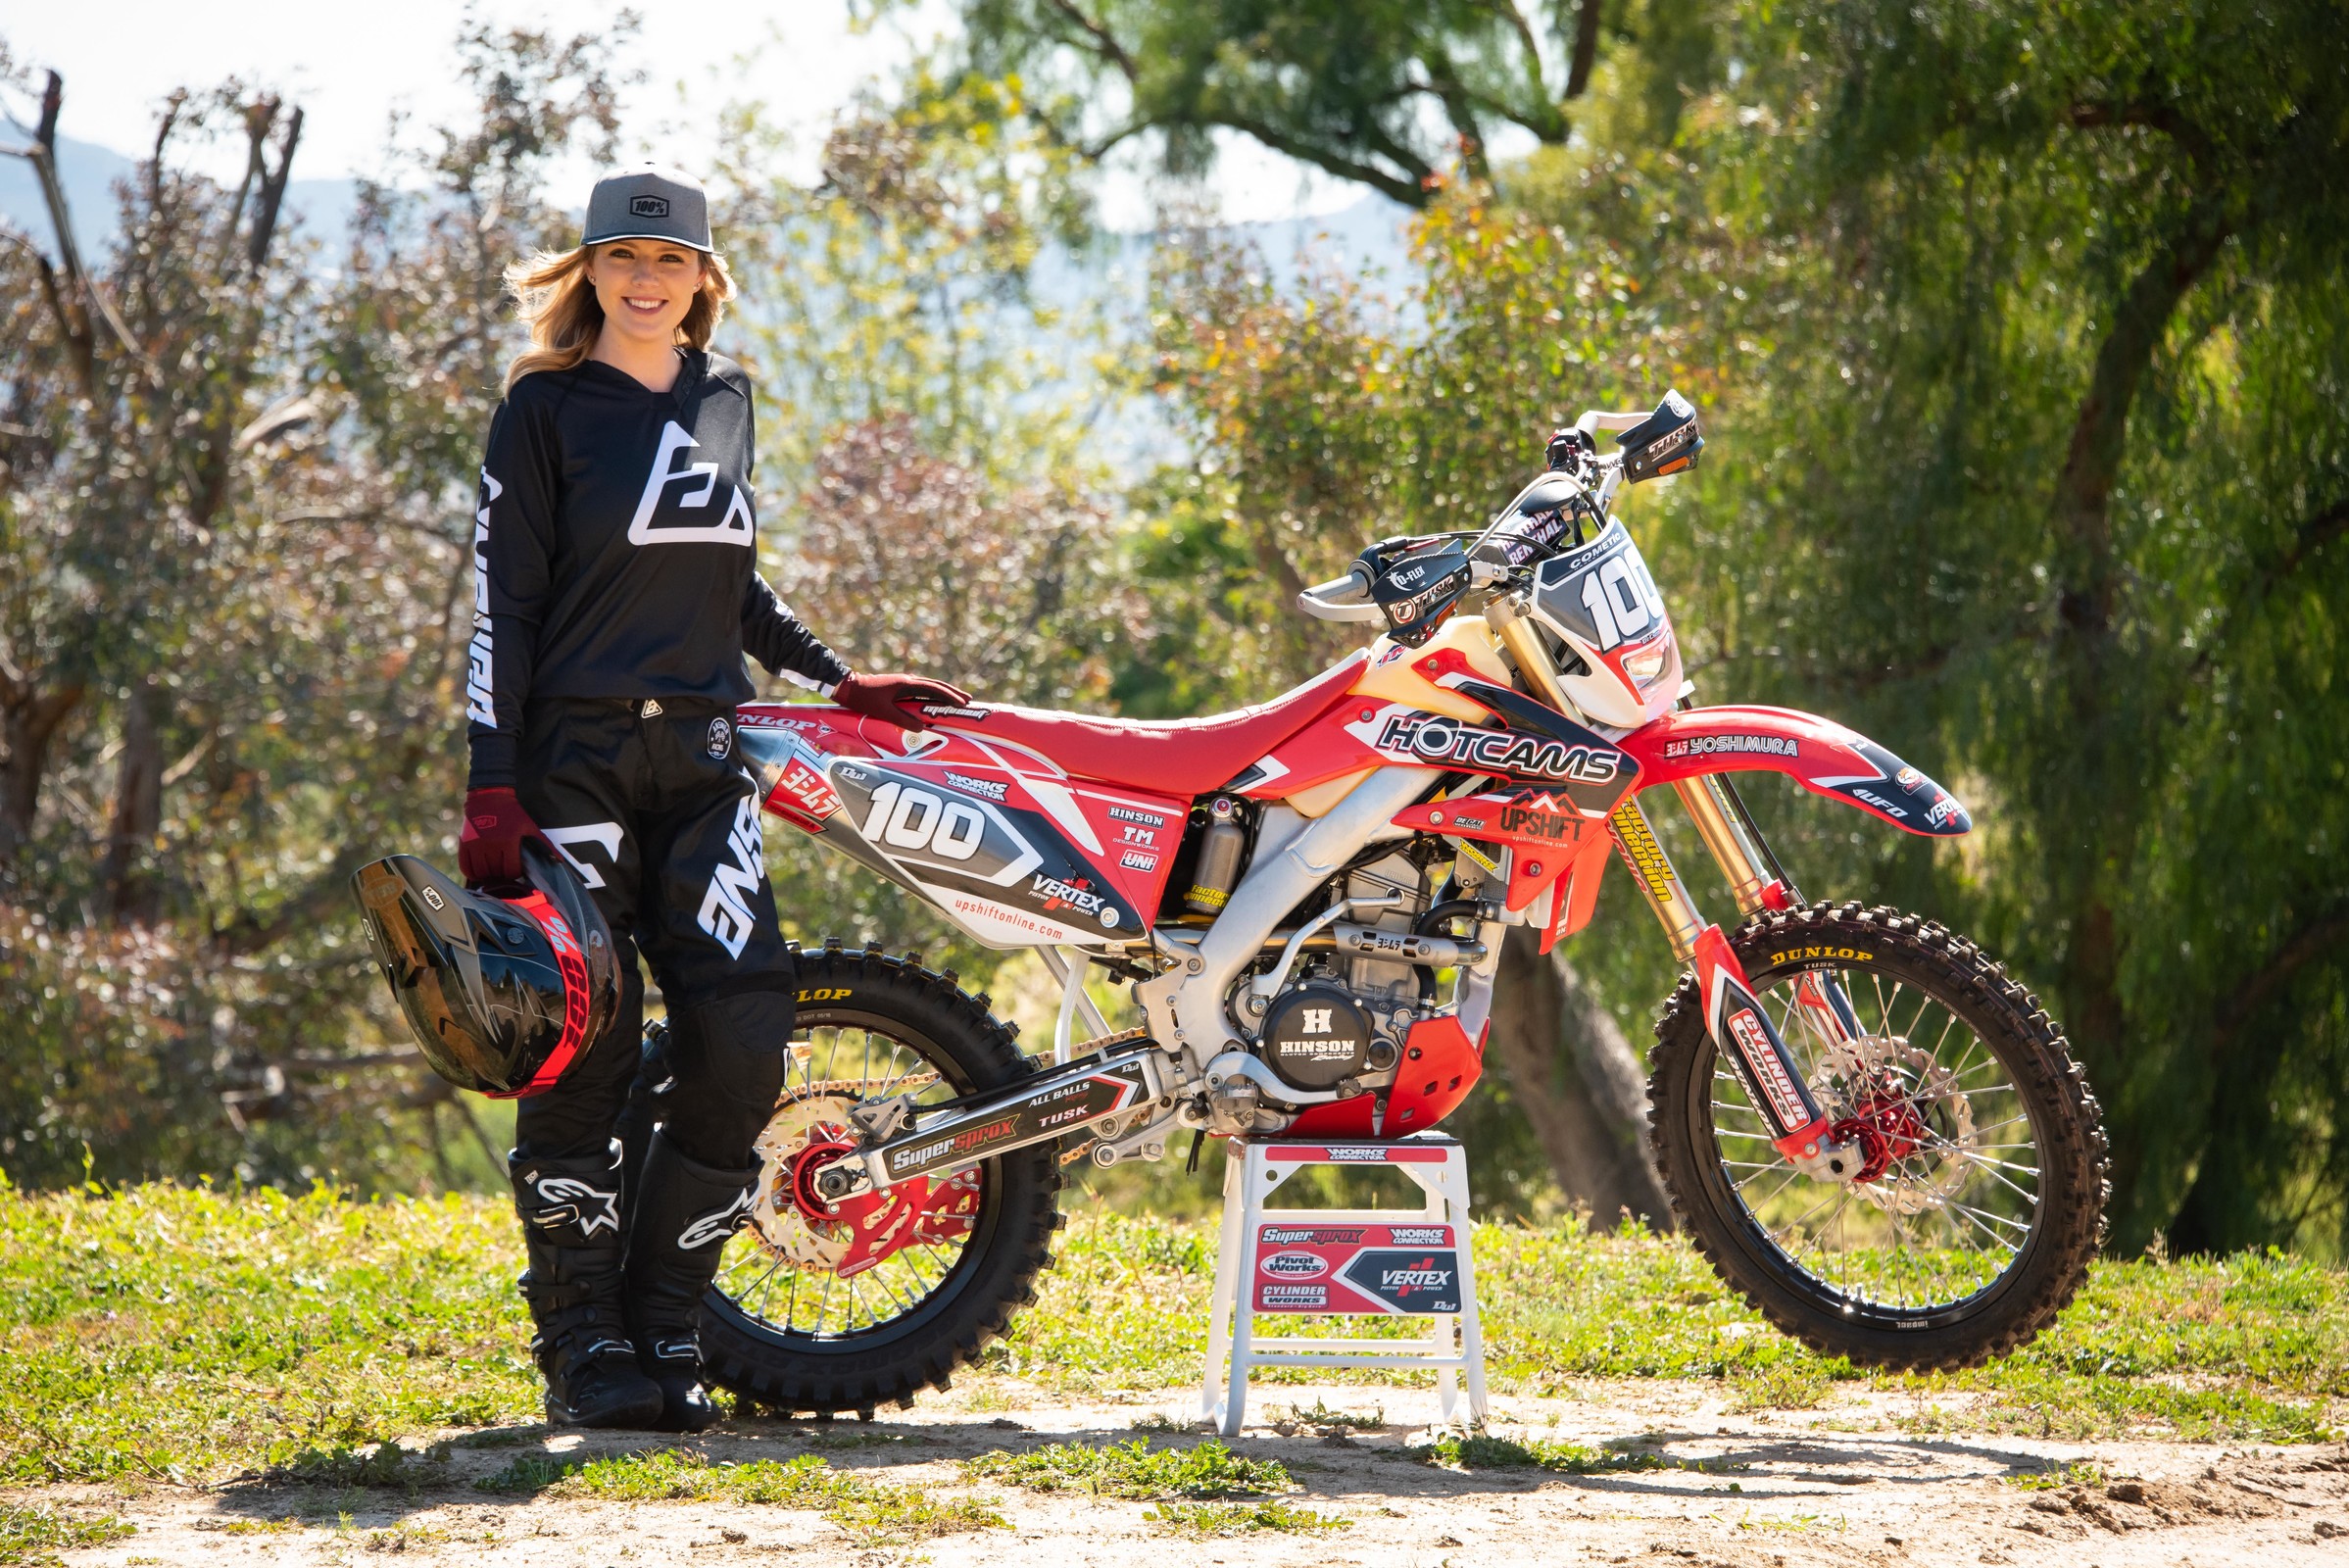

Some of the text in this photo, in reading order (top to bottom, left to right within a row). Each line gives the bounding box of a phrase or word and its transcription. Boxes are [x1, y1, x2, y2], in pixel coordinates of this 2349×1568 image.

[635, 200, 665, 214] 100%
[1509, 518, 1563, 565] RENHAL
[1581, 545, 1665, 654] 100
[737, 714, 816, 731] NLOP
[1376, 715, 1622, 783] HOTCAMS
[1689, 735, 1798, 757] YOSHIMURA
[944, 771, 1008, 793] WORKS
[948, 780, 1004, 802] CONNECTION
[861, 781, 986, 860] 100
[1108, 807, 1164, 826] HINSON
[1500, 807, 1585, 842] UPSHIFT
[1124, 827, 1154, 845] TM
[1512, 835, 1568, 849] upshiftonline.com
[1125, 853, 1154, 870] UNI
[1032, 874, 1105, 912] VERTEX
[955, 899, 1063, 940] upshiftonline.com
[1770, 947, 1874, 966] DUNLOP
[792, 988, 853, 1003] LOP
[1302, 1008, 1333, 1034] H
[1280, 1040, 1355, 1054] HINSON
[1738, 1028, 1791, 1117] WORKS
[1742, 1014, 1808, 1122] CYLINDER
[1028, 1094, 1051, 1108] ALL
[1052, 1081, 1091, 1101] BALLS
[1039, 1103, 1090, 1128] TUSK
[893, 1119, 1013, 1171] Supersprox
[1262, 1228, 1363, 1245] Supersprox
[1390, 1229, 1445, 1239] WORKS
[1269, 1263, 1321, 1272] Works
[1382, 1270, 1452, 1286] VERTEX
[1263, 1286, 1326, 1296] CYLINDER
